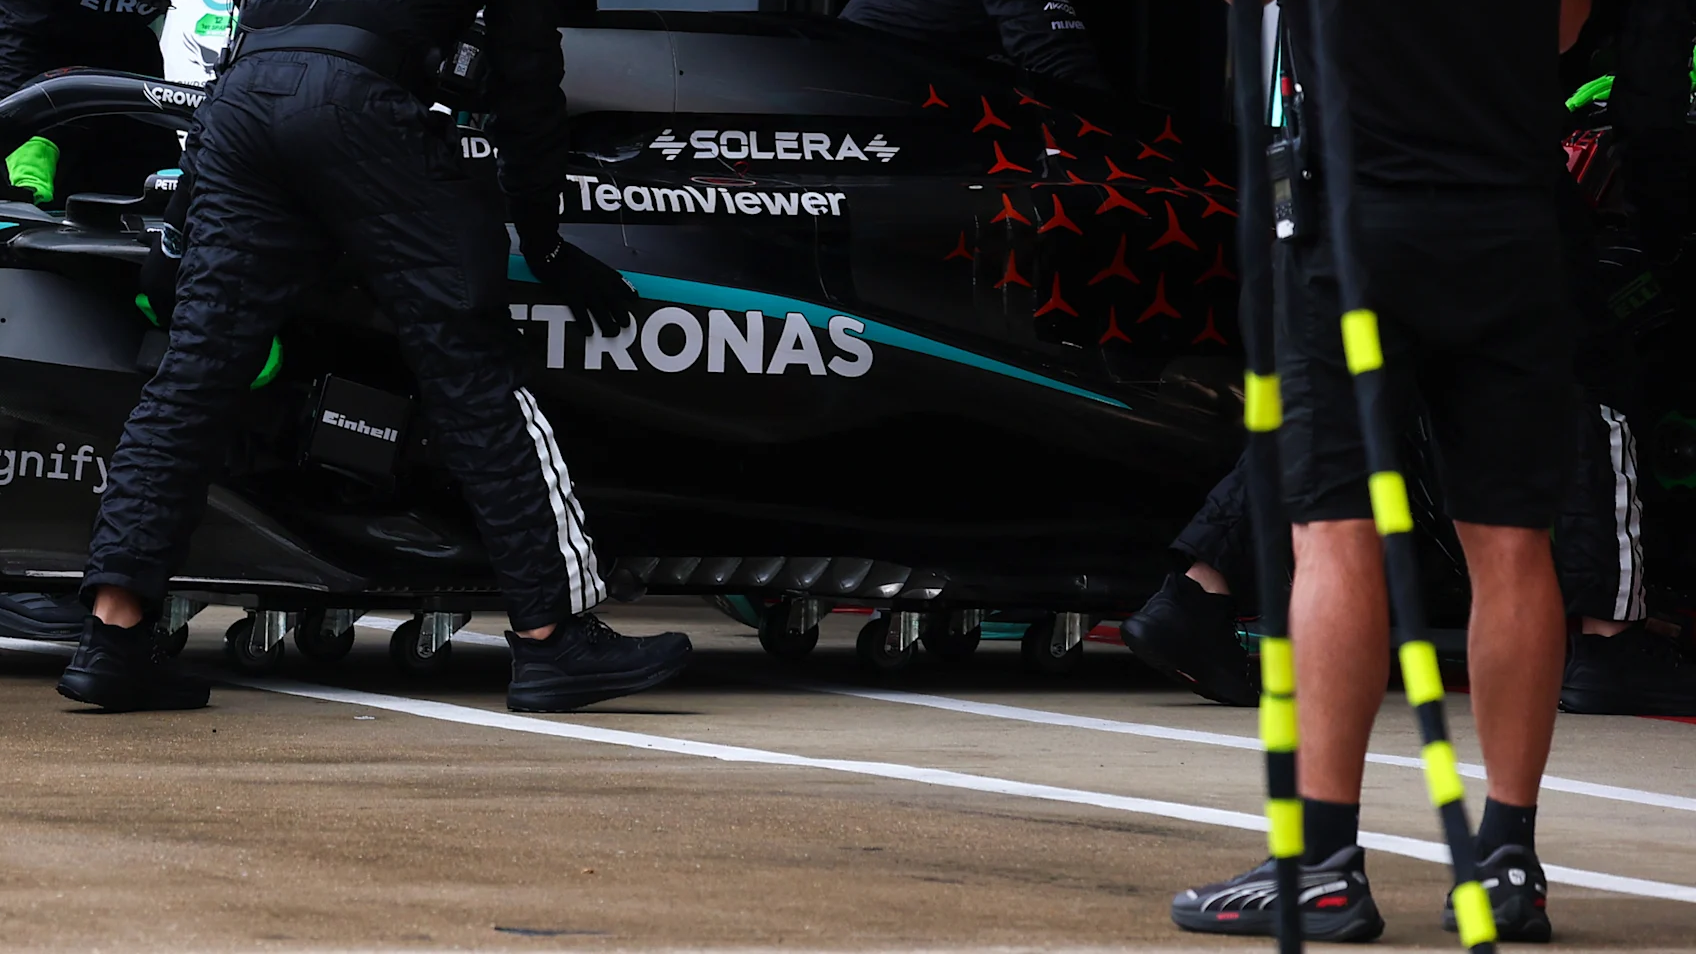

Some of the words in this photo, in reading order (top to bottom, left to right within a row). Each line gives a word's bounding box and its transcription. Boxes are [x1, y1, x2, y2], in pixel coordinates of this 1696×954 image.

[151, 87, 207, 109] CROW
[690, 130, 869, 161] SOLERA
[565, 174, 846, 217] TeamViewer
[508, 303, 874, 378] TRONAS
[322, 409, 398, 443] Einhell
